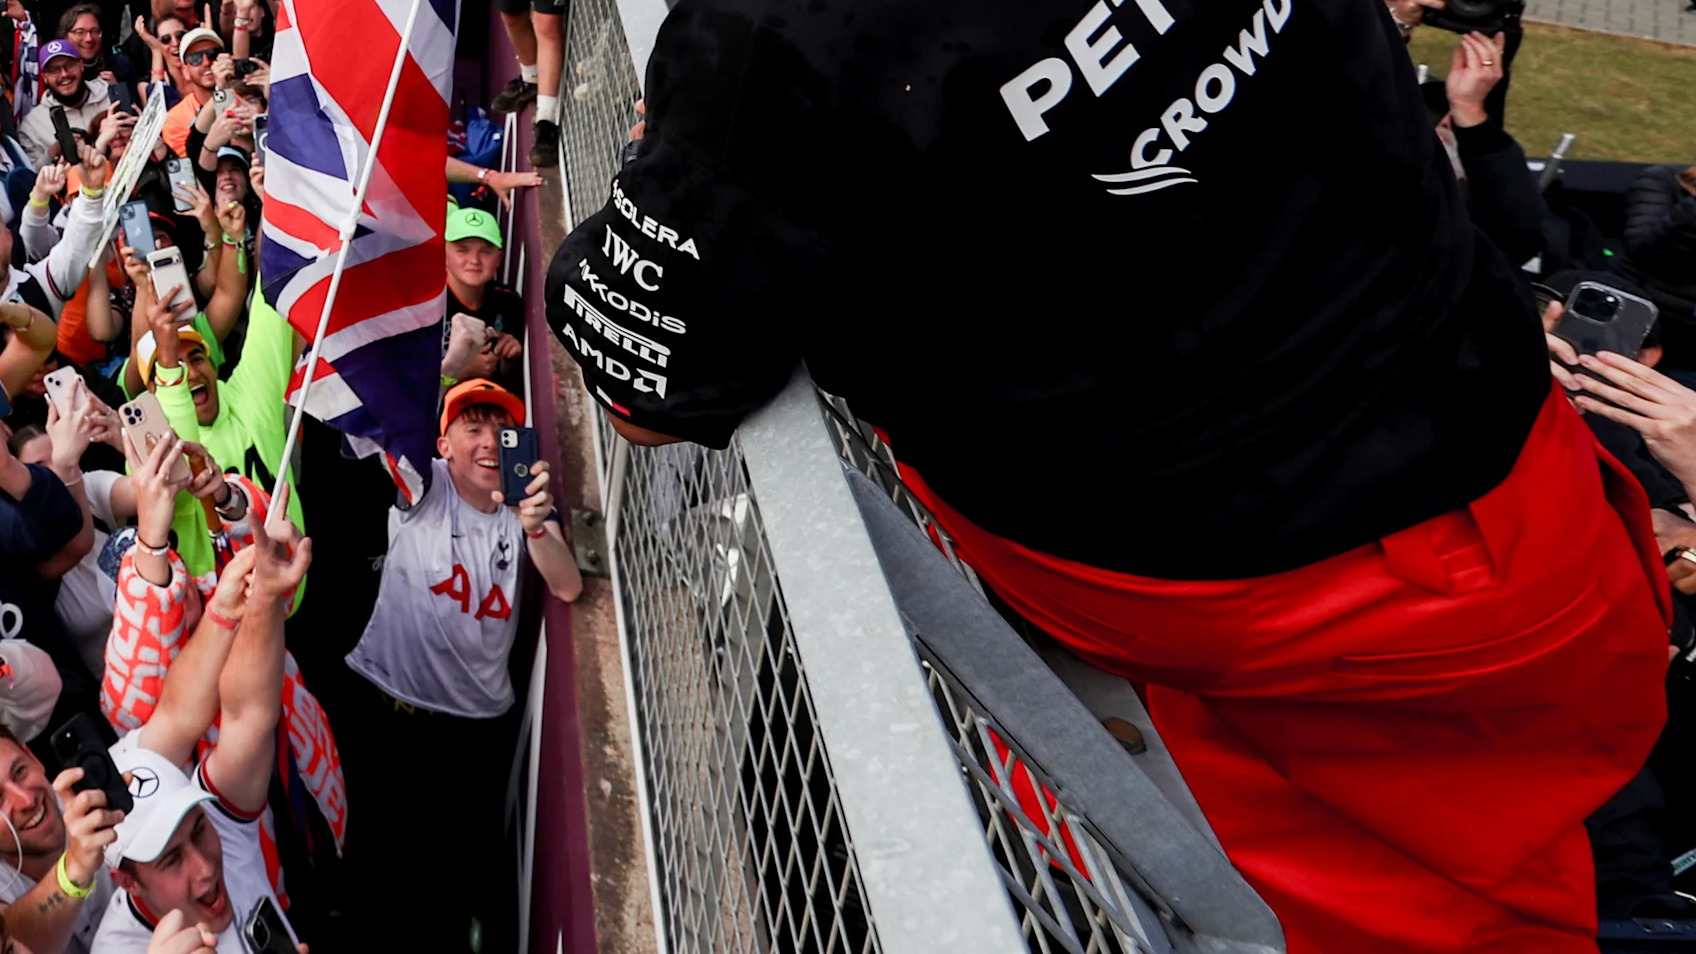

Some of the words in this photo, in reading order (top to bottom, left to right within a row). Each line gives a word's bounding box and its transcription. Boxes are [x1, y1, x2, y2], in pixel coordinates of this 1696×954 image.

[602, 224, 664, 291] IWC
[613, 187, 700, 260] SOLERA
[562, 323, 631, 381] AMD
[563, 283, 671, 368] PIRELLI
